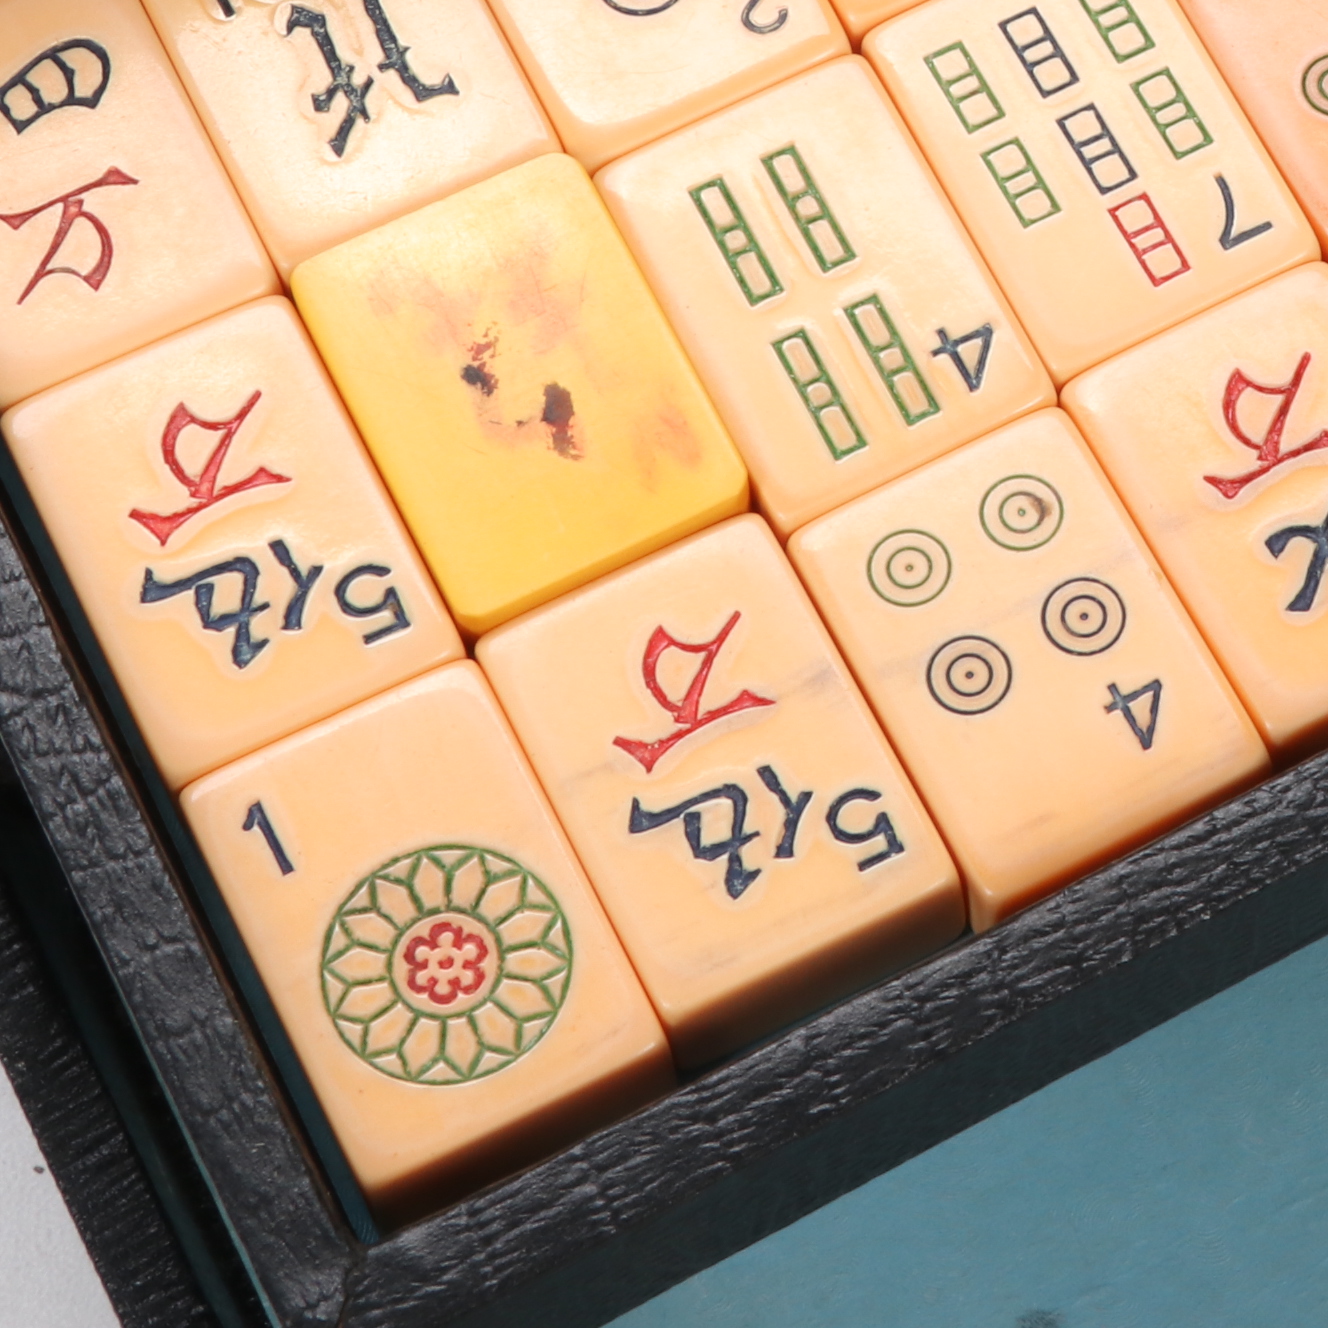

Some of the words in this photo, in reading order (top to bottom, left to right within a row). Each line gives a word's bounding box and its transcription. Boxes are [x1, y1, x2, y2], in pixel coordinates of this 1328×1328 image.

[1216, 176, 1272, 250] 7
[932, 326, 993, 392] 4
[334, 563, 411, 645] 5
[1105, 679, 1163, 750] 4
[242, 801, 294, 875] 1
[825, 787, 905, 872] 5
